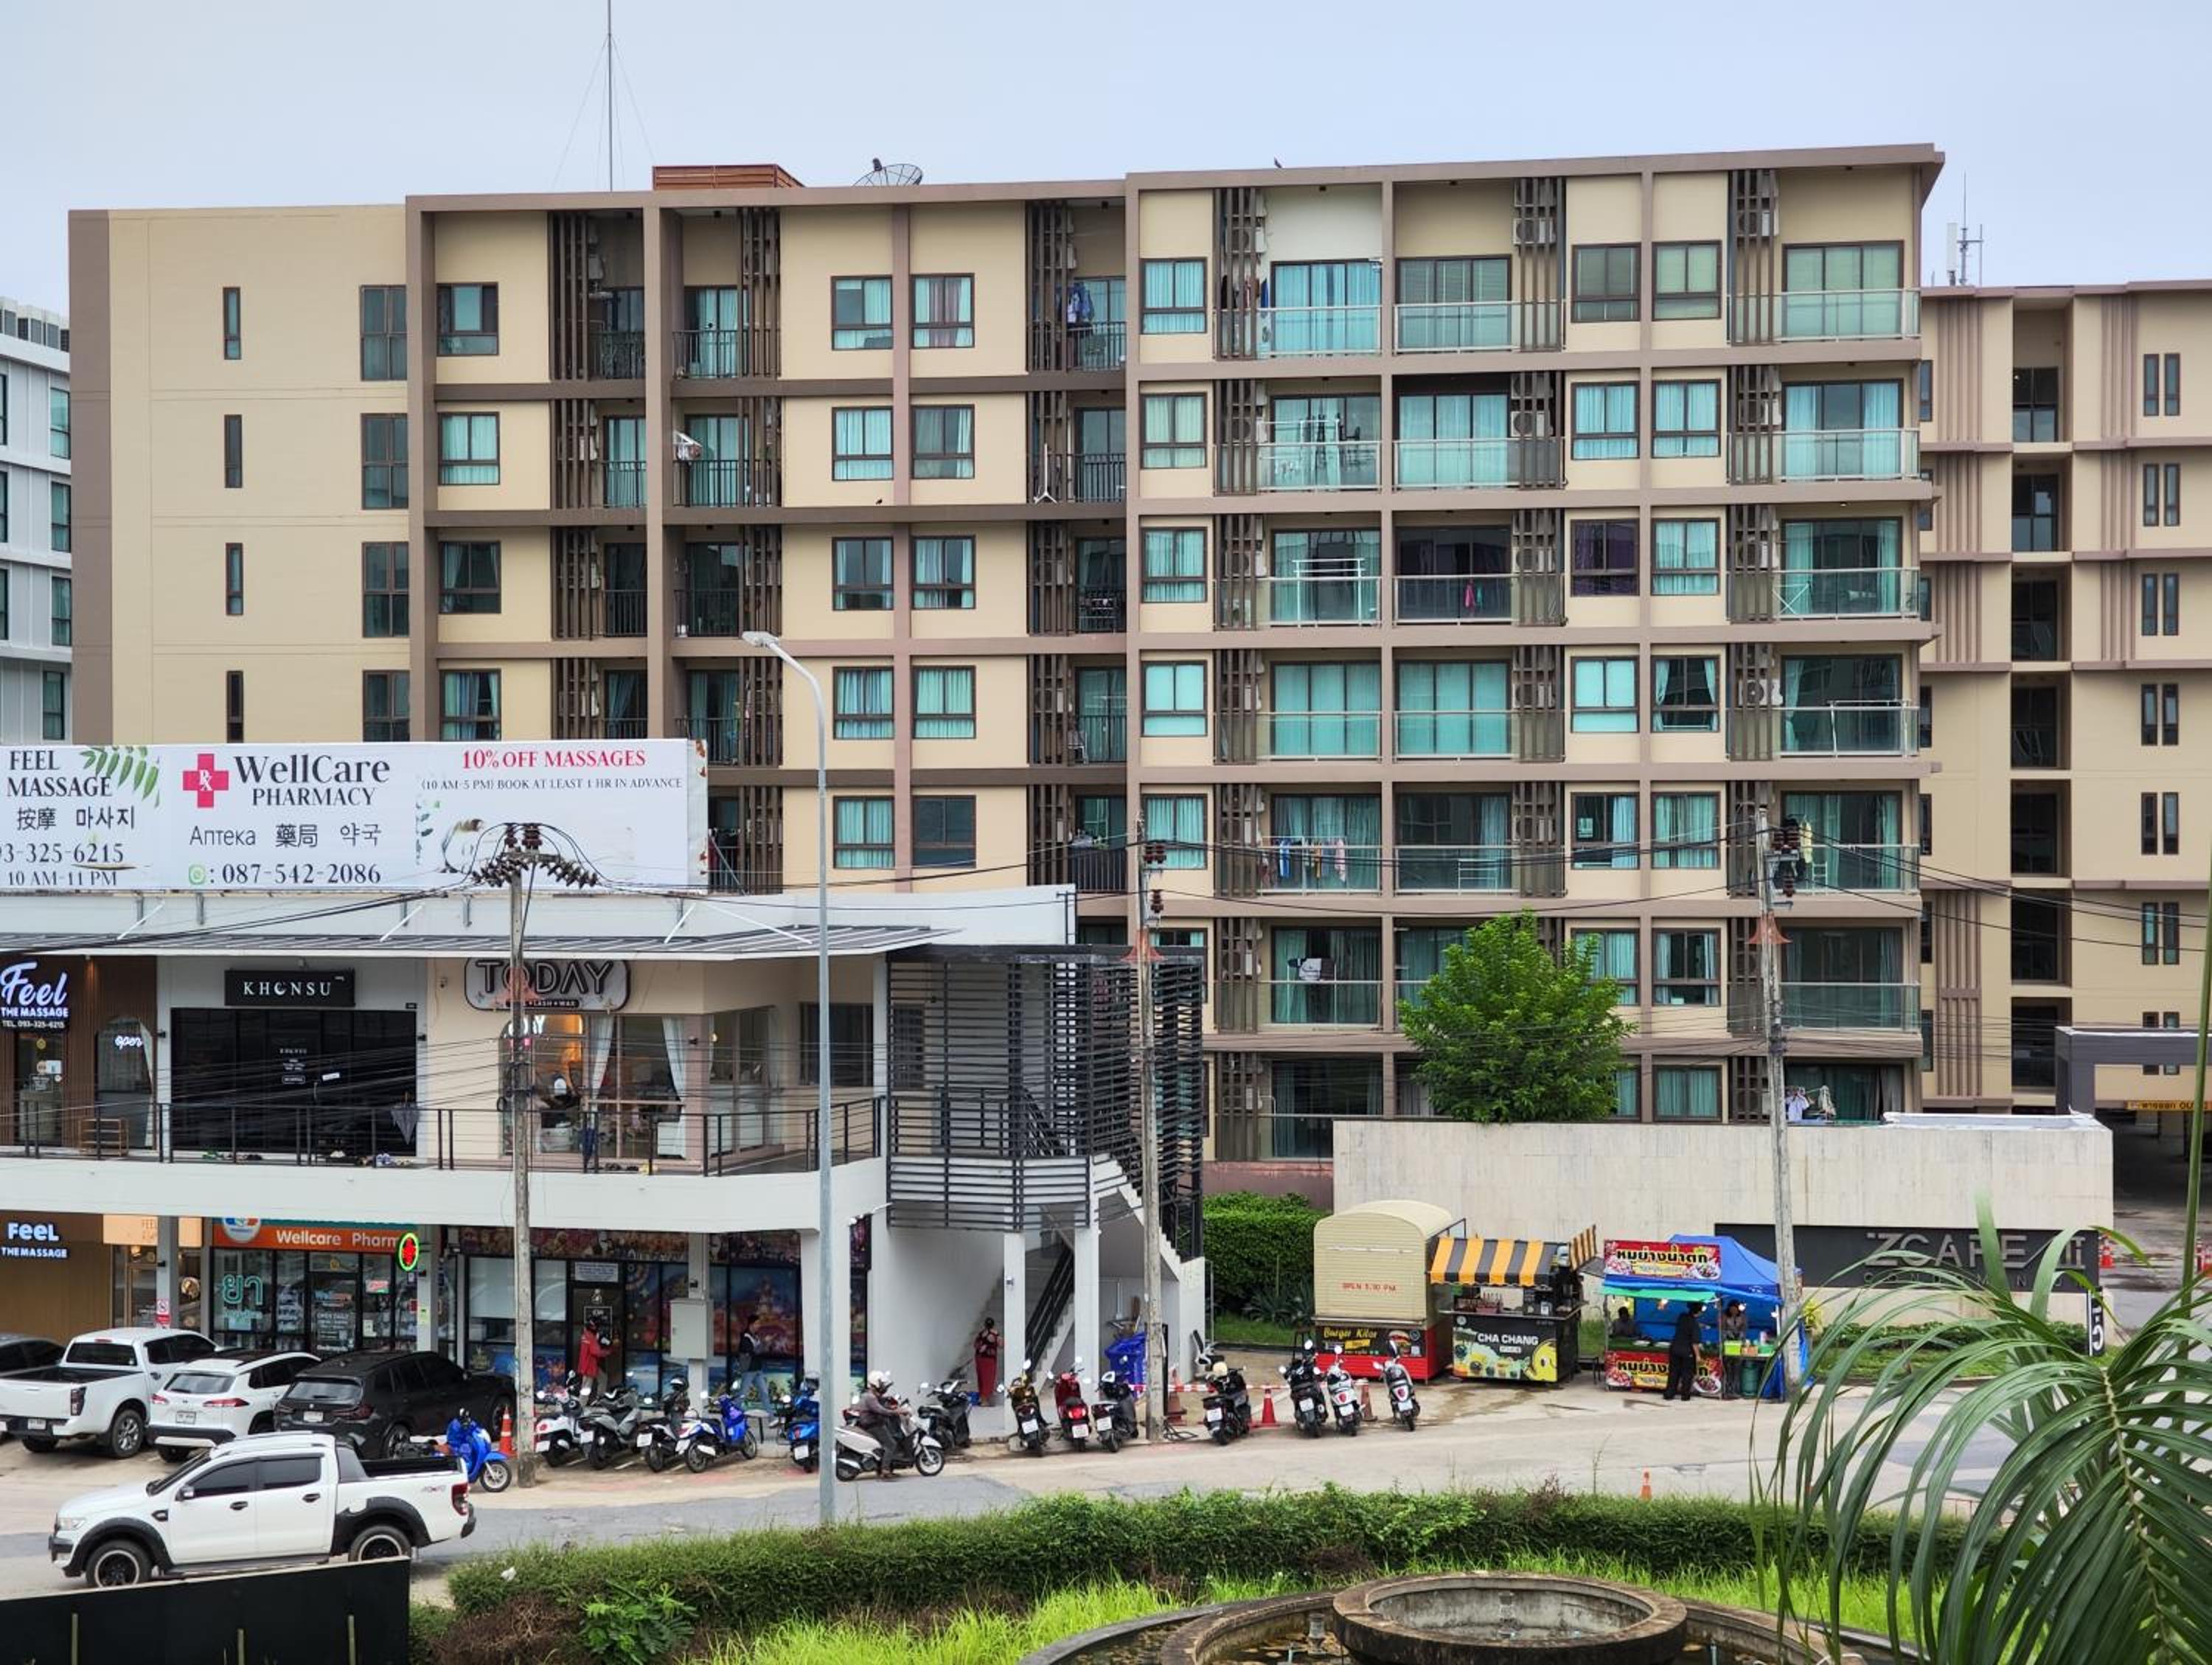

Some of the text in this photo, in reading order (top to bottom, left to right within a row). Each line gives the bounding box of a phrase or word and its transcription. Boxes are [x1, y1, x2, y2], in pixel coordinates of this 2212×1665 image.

[10, 750, 59, 771] FEEL
[463, 749, 646, 768] 10% OFF MASSAGES
[234, 754, 391, 784] WellCare
[7, 776, 113, 797] MASSAGE
[498, 779, 529, 790] BOOK
[532, 779, 546, 789] AT
[550, 779, 582, 789] LEAST
[596, 778, 612, 788] HR
[616, 778, 627, 788] IN
[630, 778, 683, 788] ADVANCE
[253, 788, 376, 806] PHARMACY
[17, 807, 57, 831] 按摩
[76, 805, 134, 830] 마사지
[189, 825, 257, 846] Аптека
[275, 823, 318, 848] 藥局
[340, 822, 381, 847] 약국
[0, 843, 124, 863] 3-325-6215
[8, 872, 24, 885] 10
[91, 872, 117, 886] PM
[223, 863, 381, 884] 087-542-2086
[0, 962, 67, 1006] Feel
[243, 981, 331, 995] KHONSU
[1, 1007, 69, 1018] THE MASSAGE
[2180, 1102, 2195, 1110] OU
[276, 1229, 398, 1248] Wellcare Pharm
[1, 1247, 68, 1259] THE MASSAGE
[223, 1273, 262, 1305] ยา
[1477, 1332, 1539, 1346] CHA CHANG
